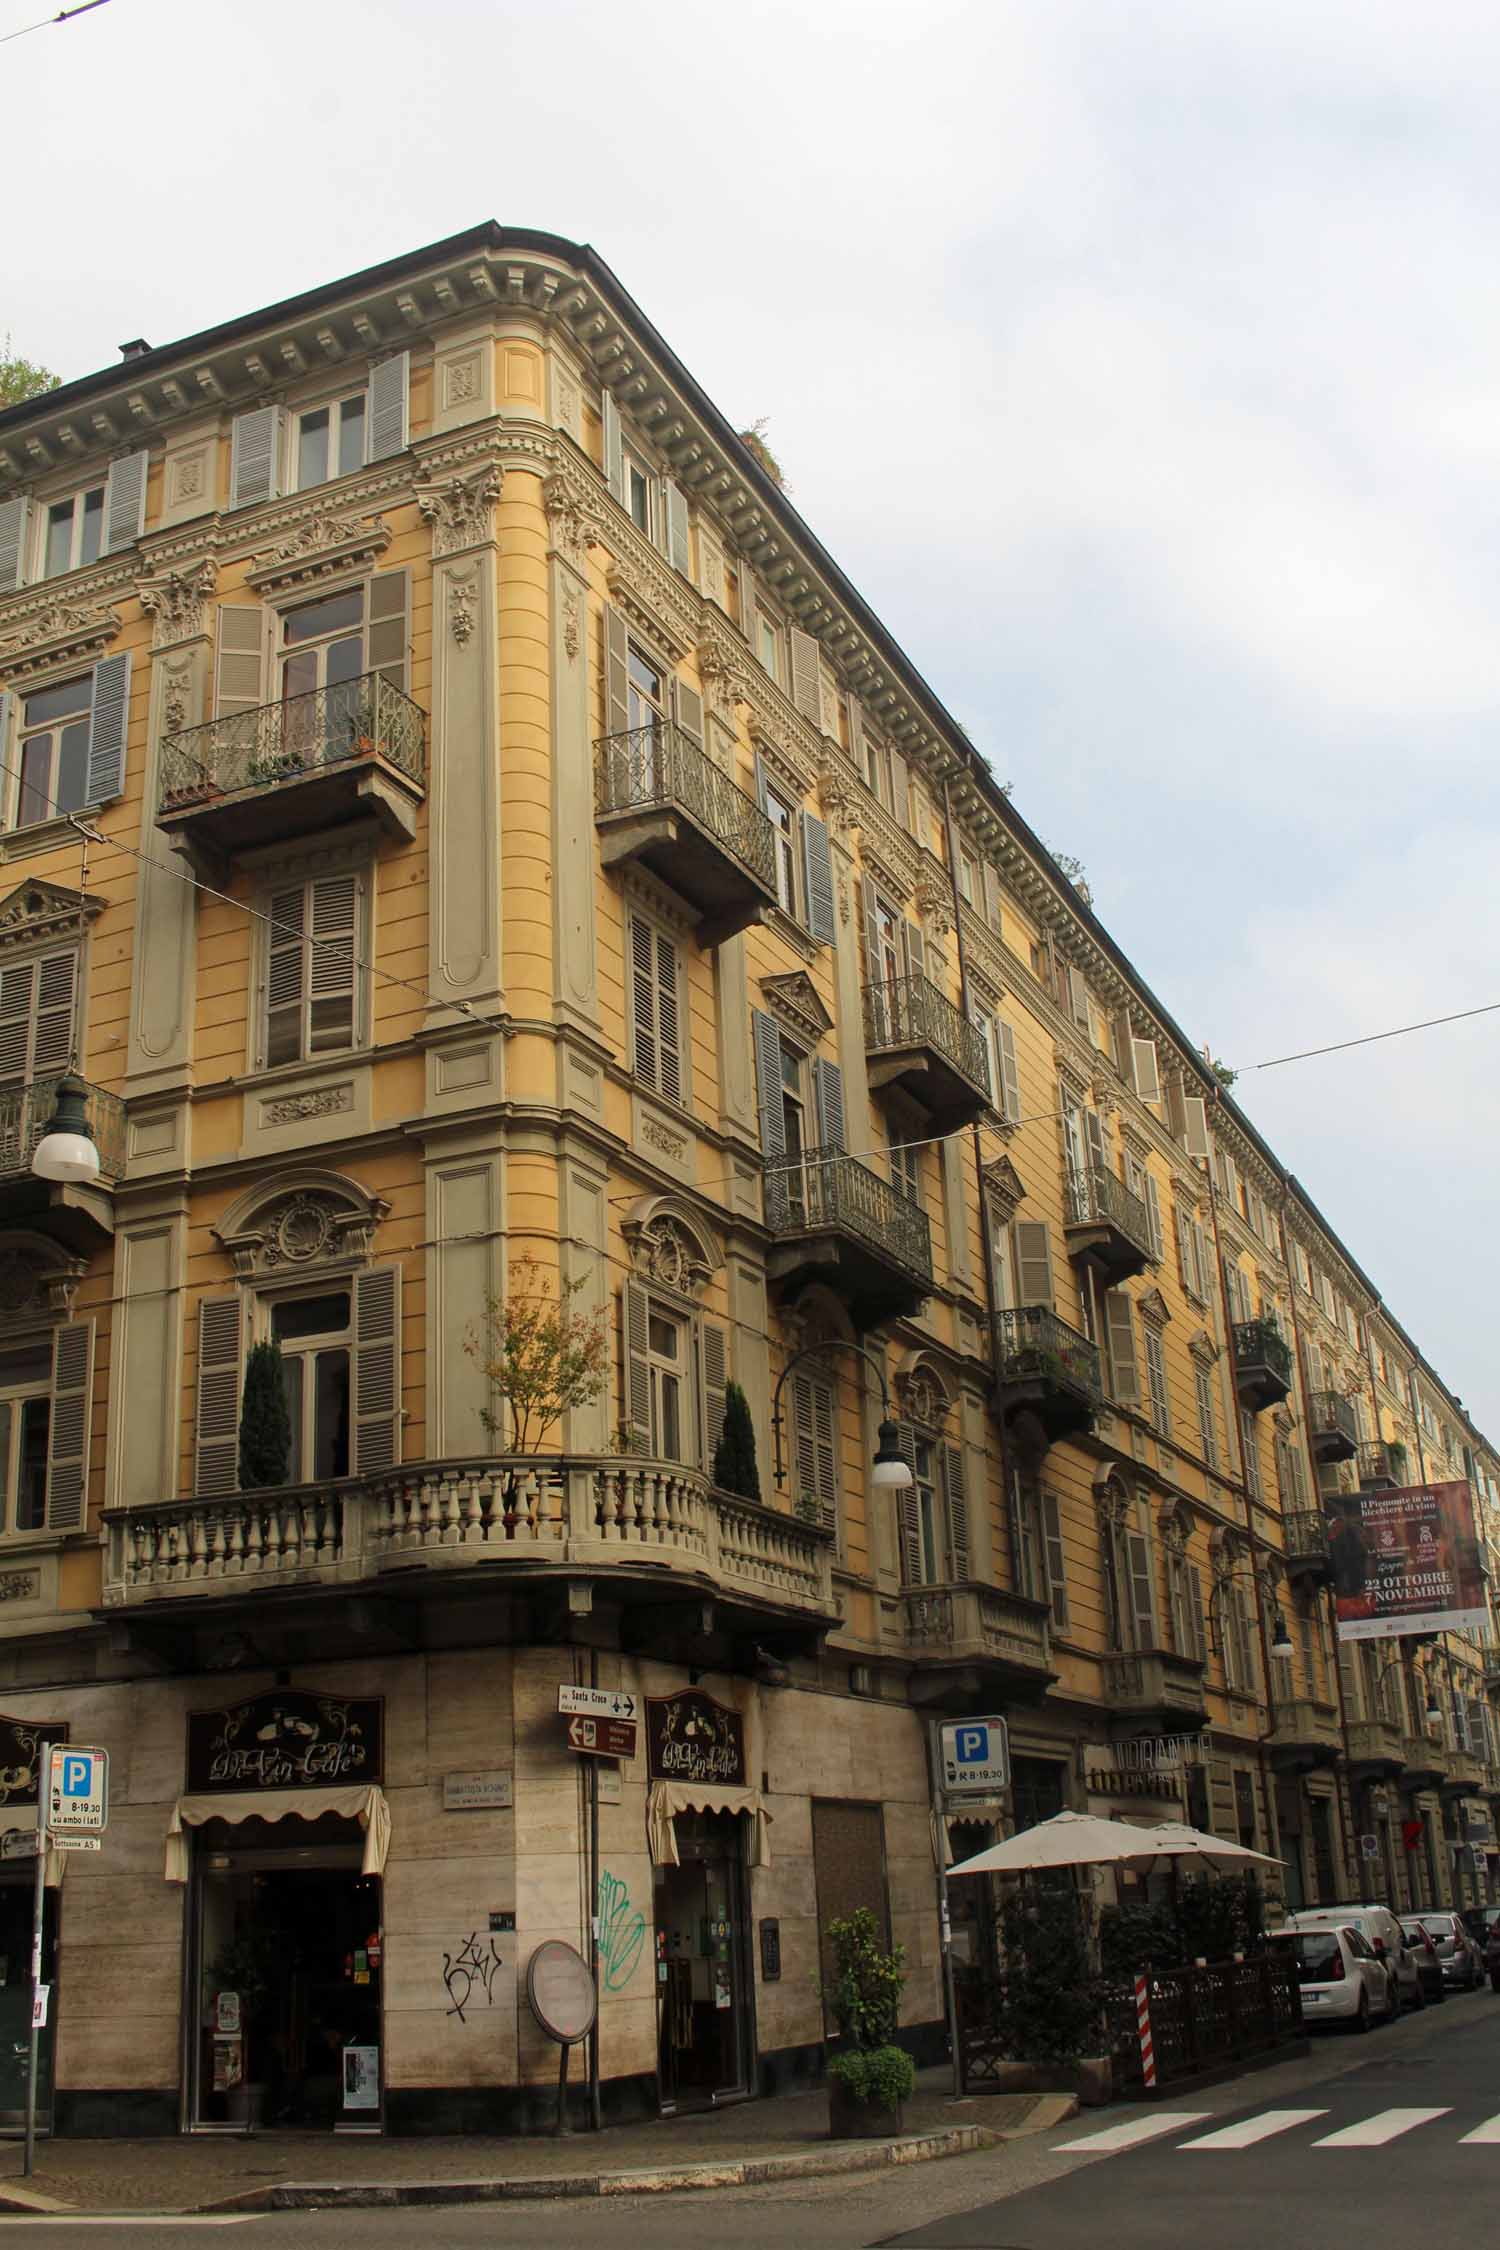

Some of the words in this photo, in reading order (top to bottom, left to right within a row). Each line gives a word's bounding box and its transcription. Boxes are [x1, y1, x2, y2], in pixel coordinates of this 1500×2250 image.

[1368, 1496, 1411, 1509] Piemonte
[1415, 1502, 1436, 1511] vino
[1365, 1578, 1381, 1591] 22
[1383, 1571, 1452, 1589] OTTOBRE
[1374, 1583, 1455, 1602] NOVEMBRE
[571, 1688, 589, 1702] Santa
[591, 1691, 607, 1704] Croce
[963, 1732, 981, 1758] P
[69, 1761, 87, 1792] P
[63, 1815, 82, 1825] ambo
[86, 1816, 100, 1825] lati
